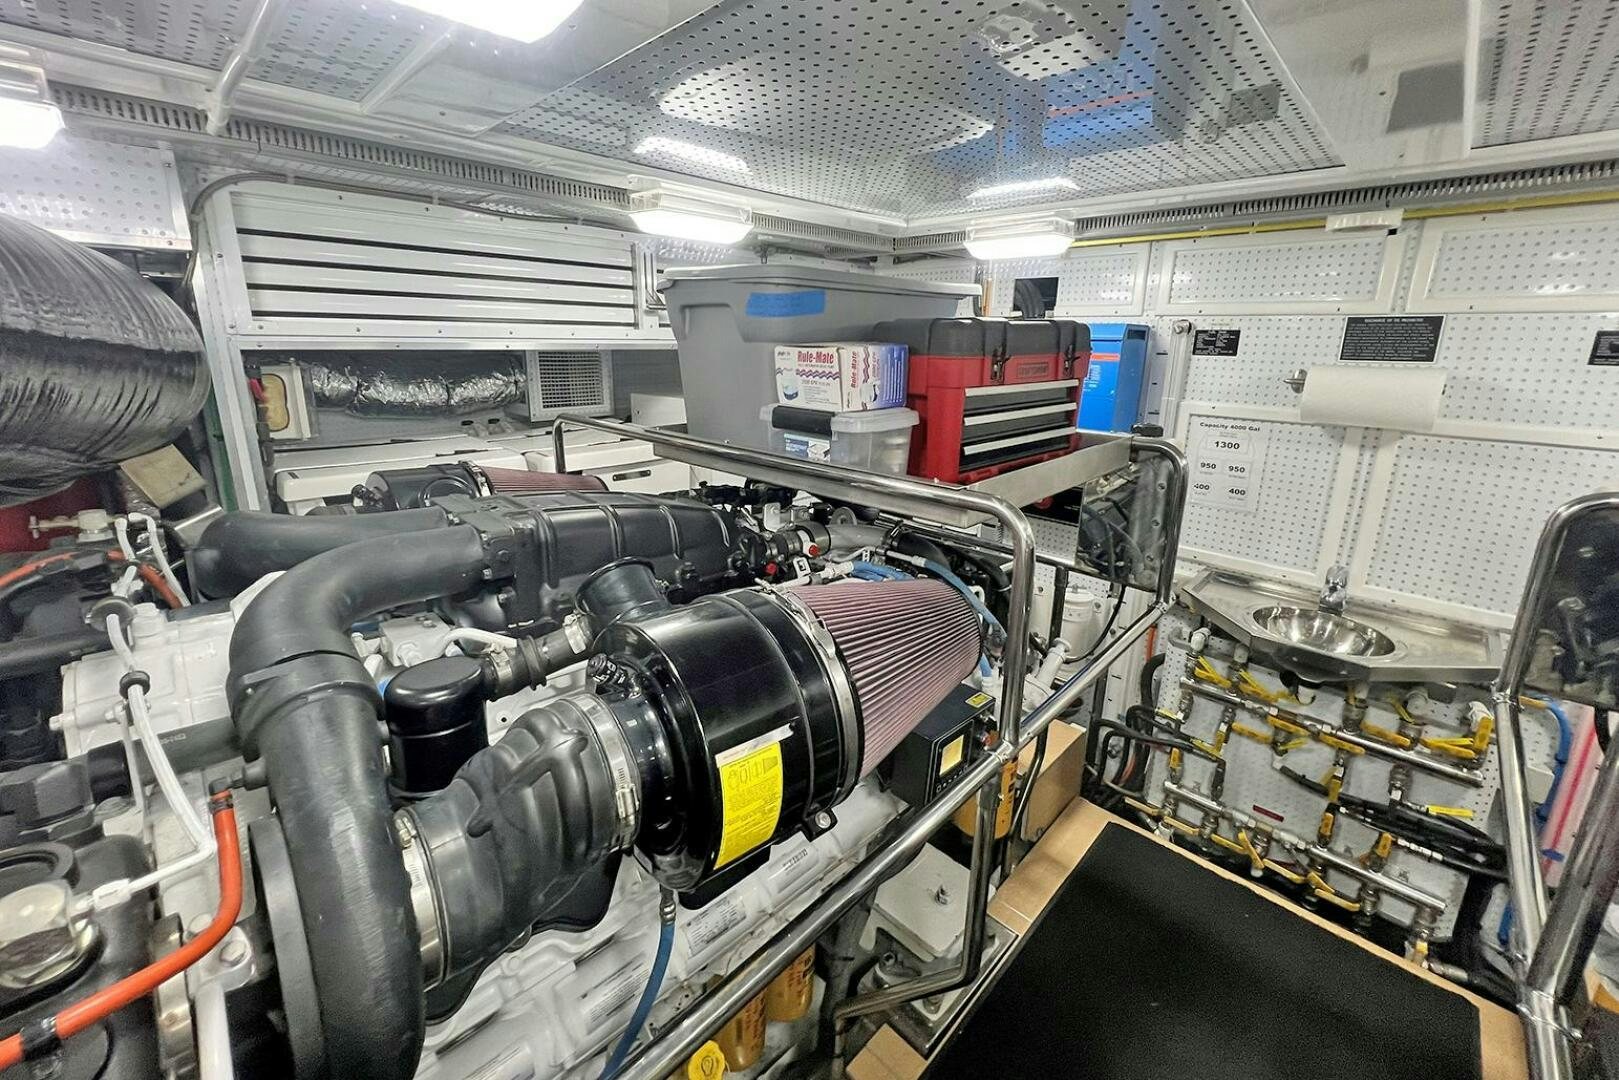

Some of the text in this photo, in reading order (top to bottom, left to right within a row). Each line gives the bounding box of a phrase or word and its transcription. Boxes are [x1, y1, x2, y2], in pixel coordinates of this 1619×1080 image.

[797, 350, 834, 364] Rule-Mate
[1199, 422, 1228, 430] Capacity
[1214, 441, 1240, 450] 1300
[1200, 462, 1246, 473] 950 950
[1193, 483, 1246, 496] 400 400
